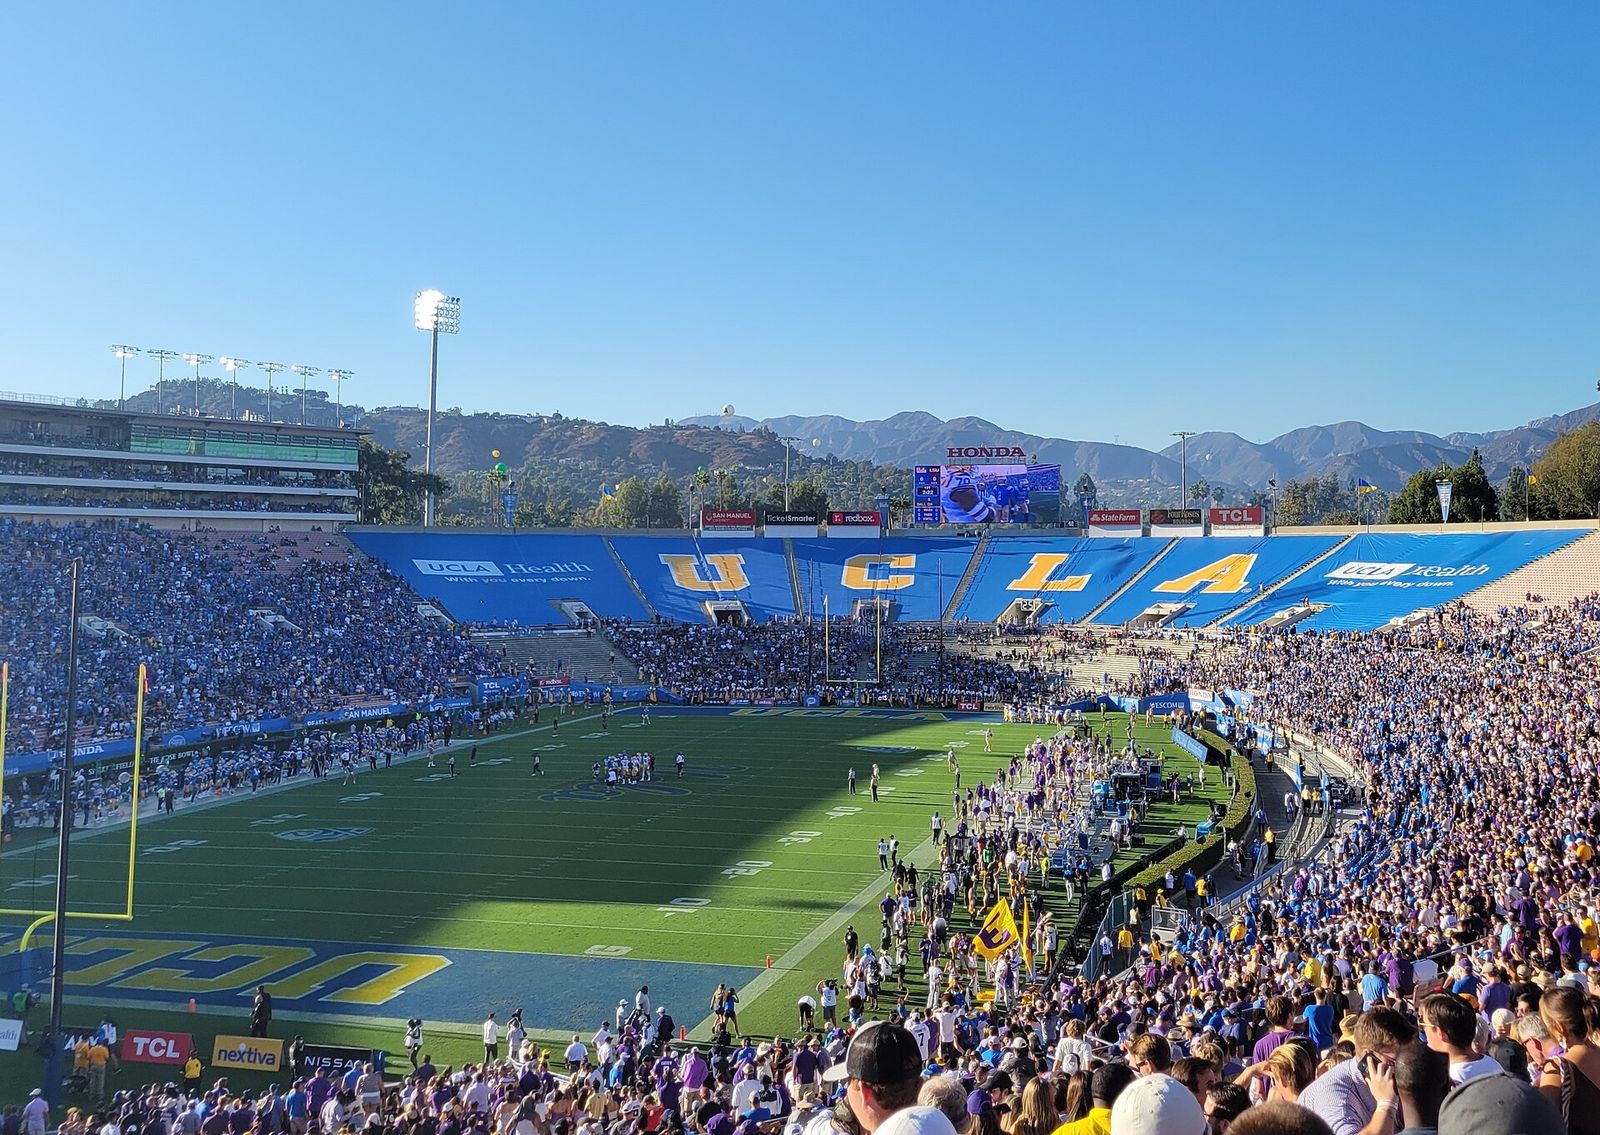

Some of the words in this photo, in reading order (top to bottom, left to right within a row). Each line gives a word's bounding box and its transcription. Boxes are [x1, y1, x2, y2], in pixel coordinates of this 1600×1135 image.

[947, 447, 1026, 457] HONDA
[767, 514, 816, 522] TicketSmarter
[1219, 510, 1253, 522] TCL
[427, 563, 491, 573] UCLA
[503, 561, 593, 575] Health
[1342, 566, 1395, 576] UCLA
[483, 682, 501, 690] TCL
[361, 708, 392, 718] MANUEL
[729, 708, 954, 721] UCLA
[721, 860, 773, 877] 20
[656, 897, 712, 914] 10
[918, 1032, 925, 1046] 7
[132, 1036, 181, 1059] TCL
[217, 1043, 276, 1066] nextiva
[304, 1055, 367, 1069] NISSA
